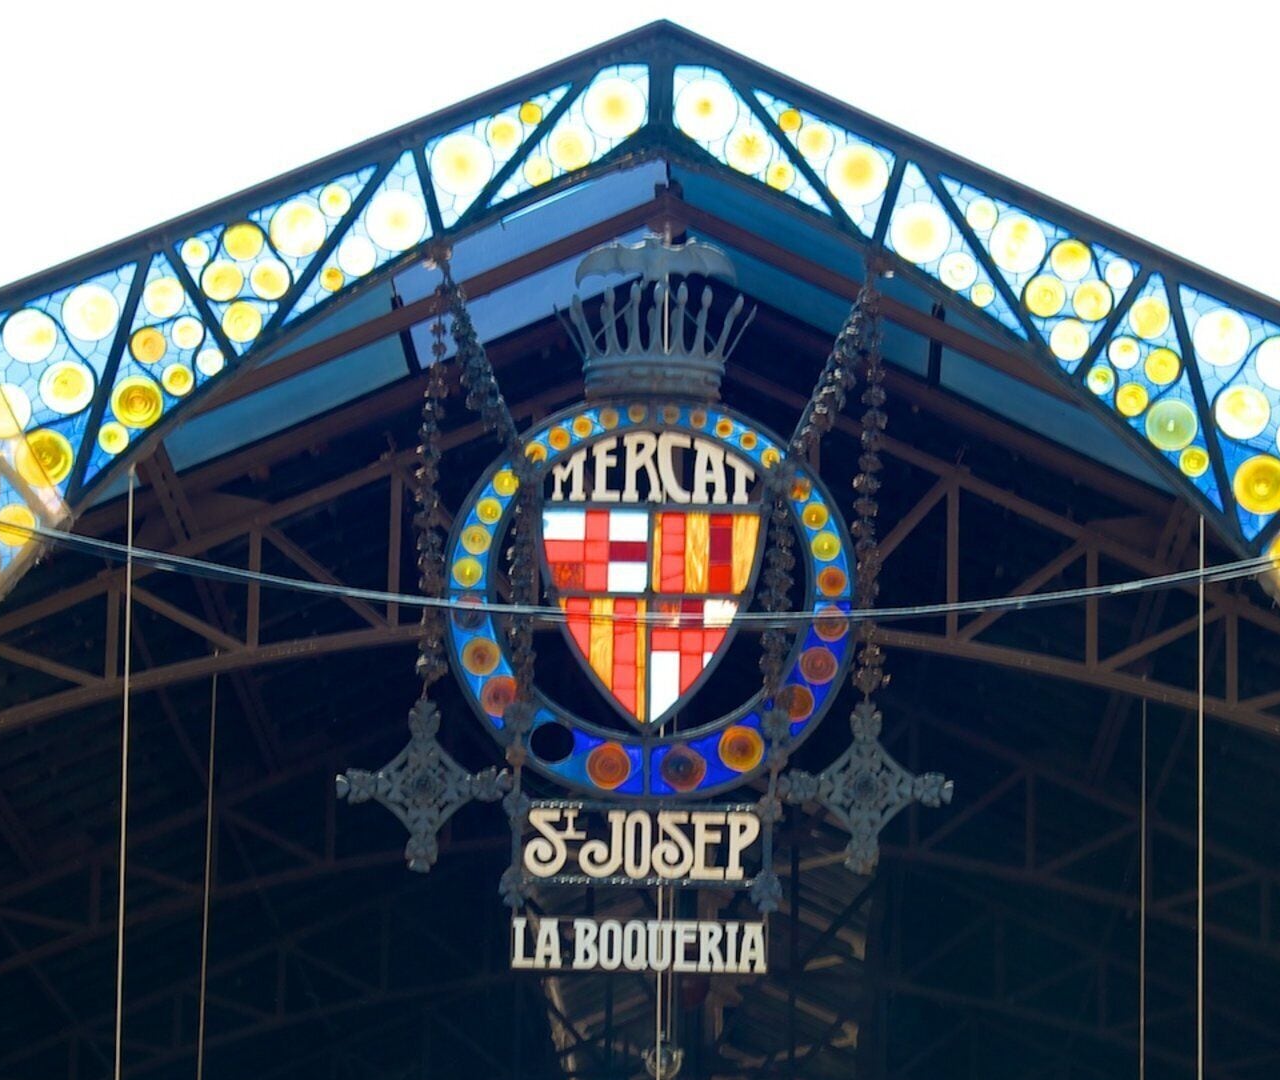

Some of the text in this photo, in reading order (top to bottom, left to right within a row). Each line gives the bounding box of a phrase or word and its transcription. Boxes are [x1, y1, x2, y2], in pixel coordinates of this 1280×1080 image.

[552, 431, 757, 504] MERCAT
[580, 809, 760, 880] JOSEP
[512, 918, 767, 974] LA BOQUERIA
